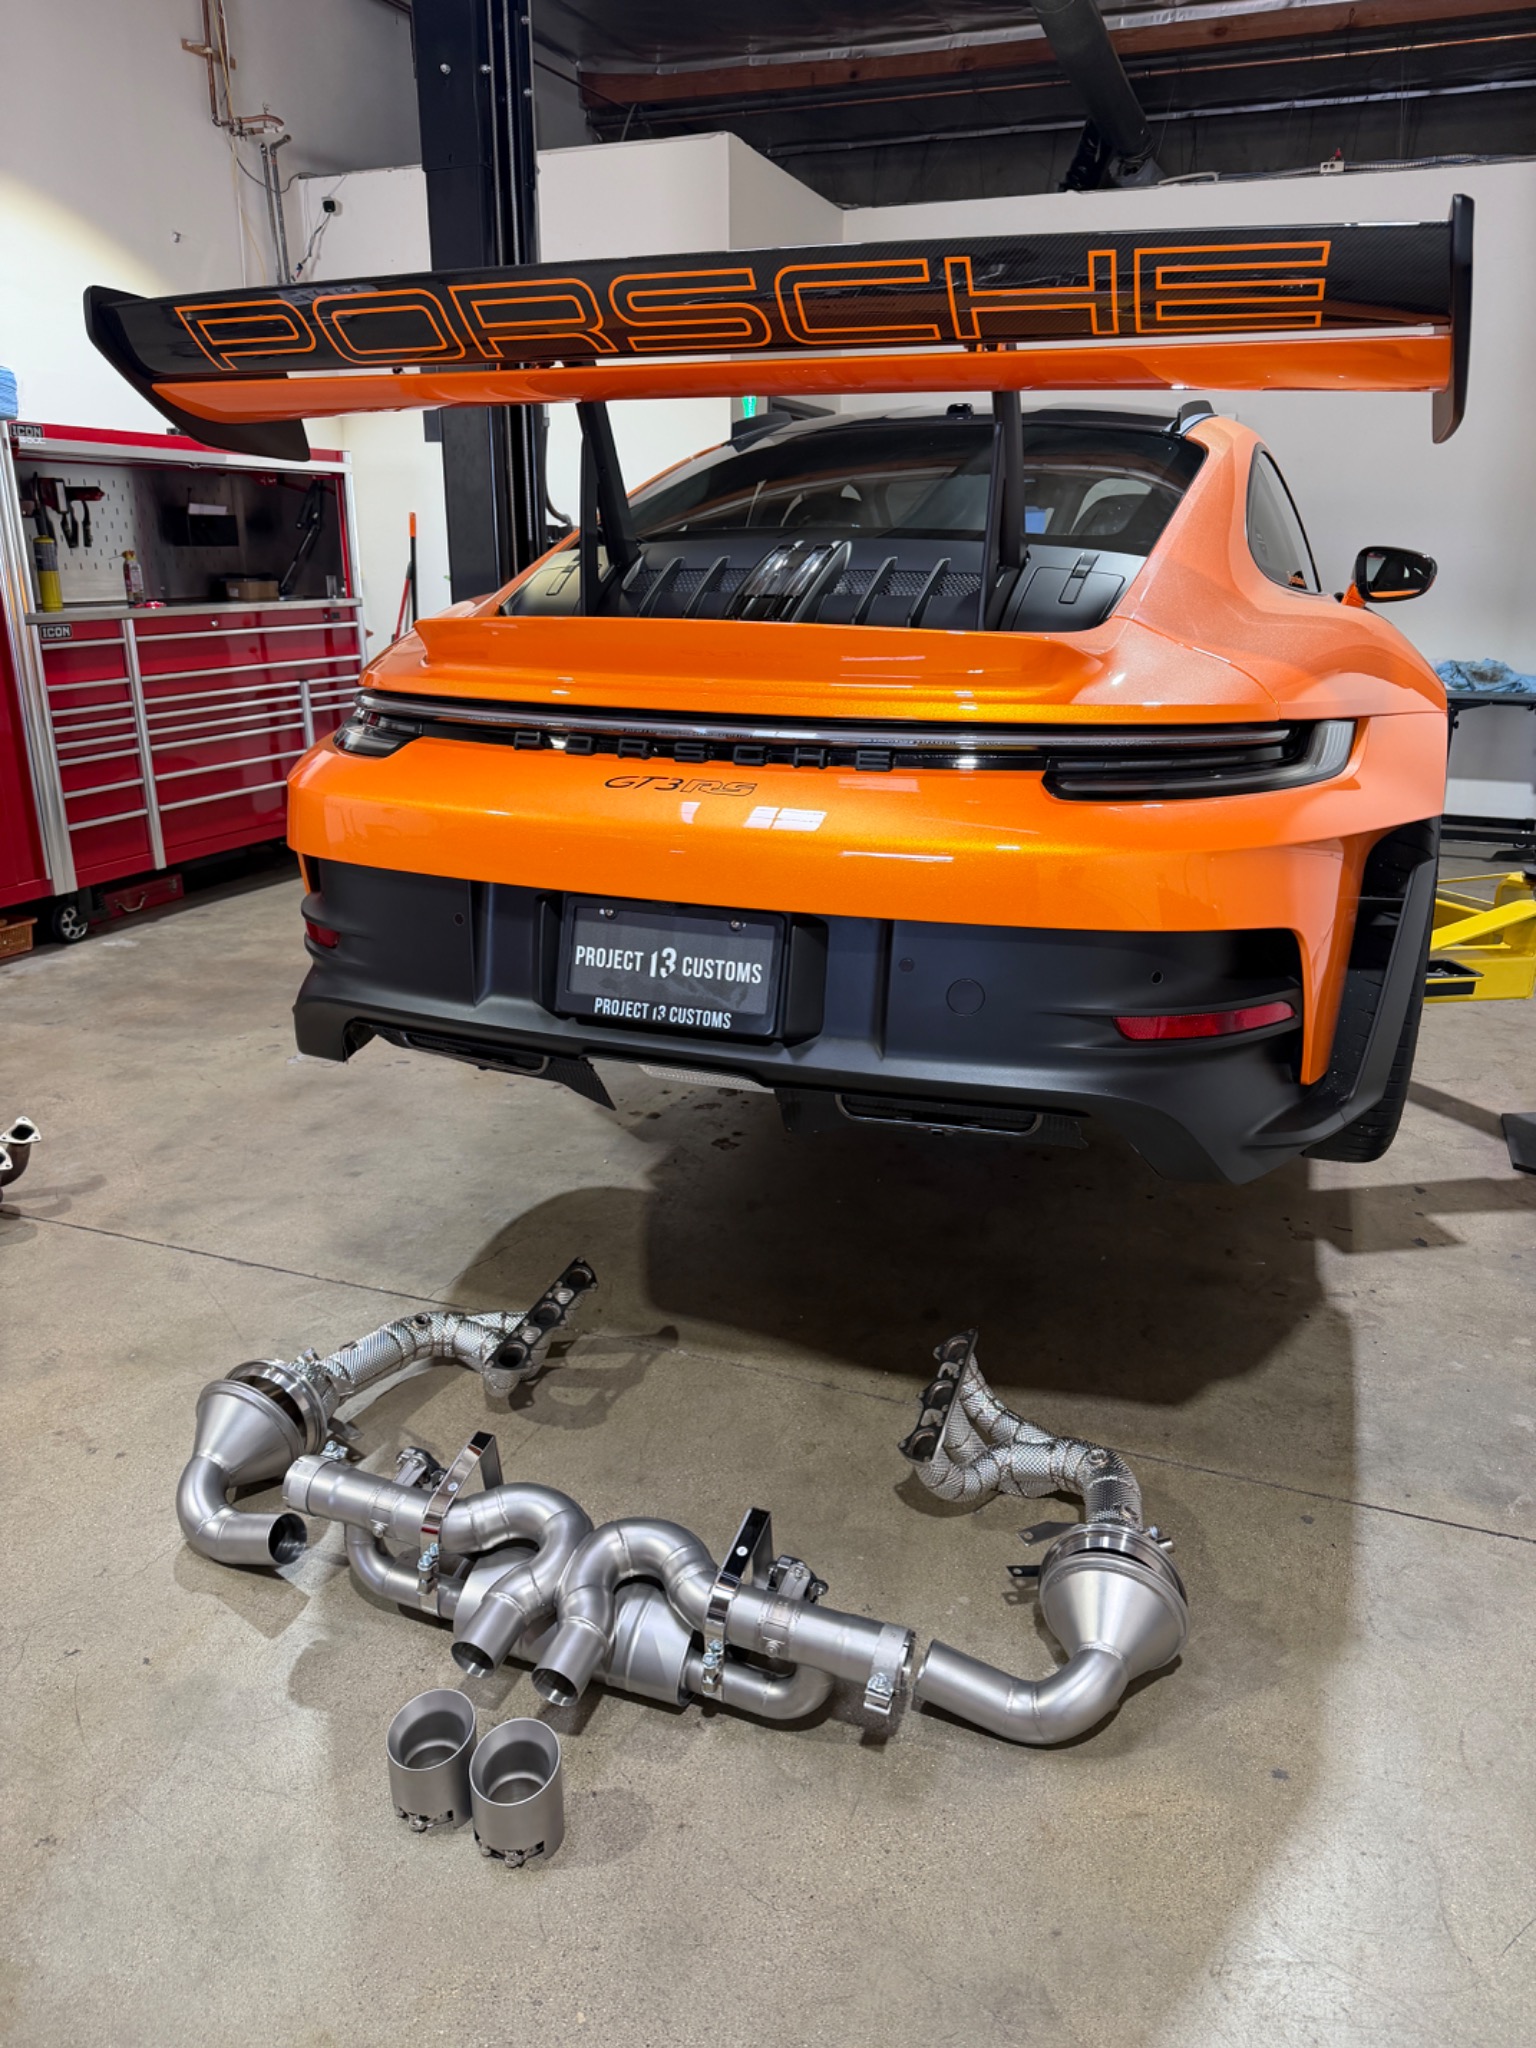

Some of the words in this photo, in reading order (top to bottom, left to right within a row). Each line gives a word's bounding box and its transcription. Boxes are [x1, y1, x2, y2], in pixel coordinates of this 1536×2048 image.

[174, 240, 1331, 370] PORSCHE
[12, 425, 42, 438] ICON
[42, 626, 70, 638] ICON
[514, 731, 893, 771] PORSCHE
[574, 945, 644, 972] PROJECT
[649, 947, 677, 978] 13
[682, 956, 763, 984] CUSTOMS
[594, 997, 650, 1019] PROJECT
[652, 1005, 666, 1021] 13
[669, 1008, 732, 1030] CUSTOMS
